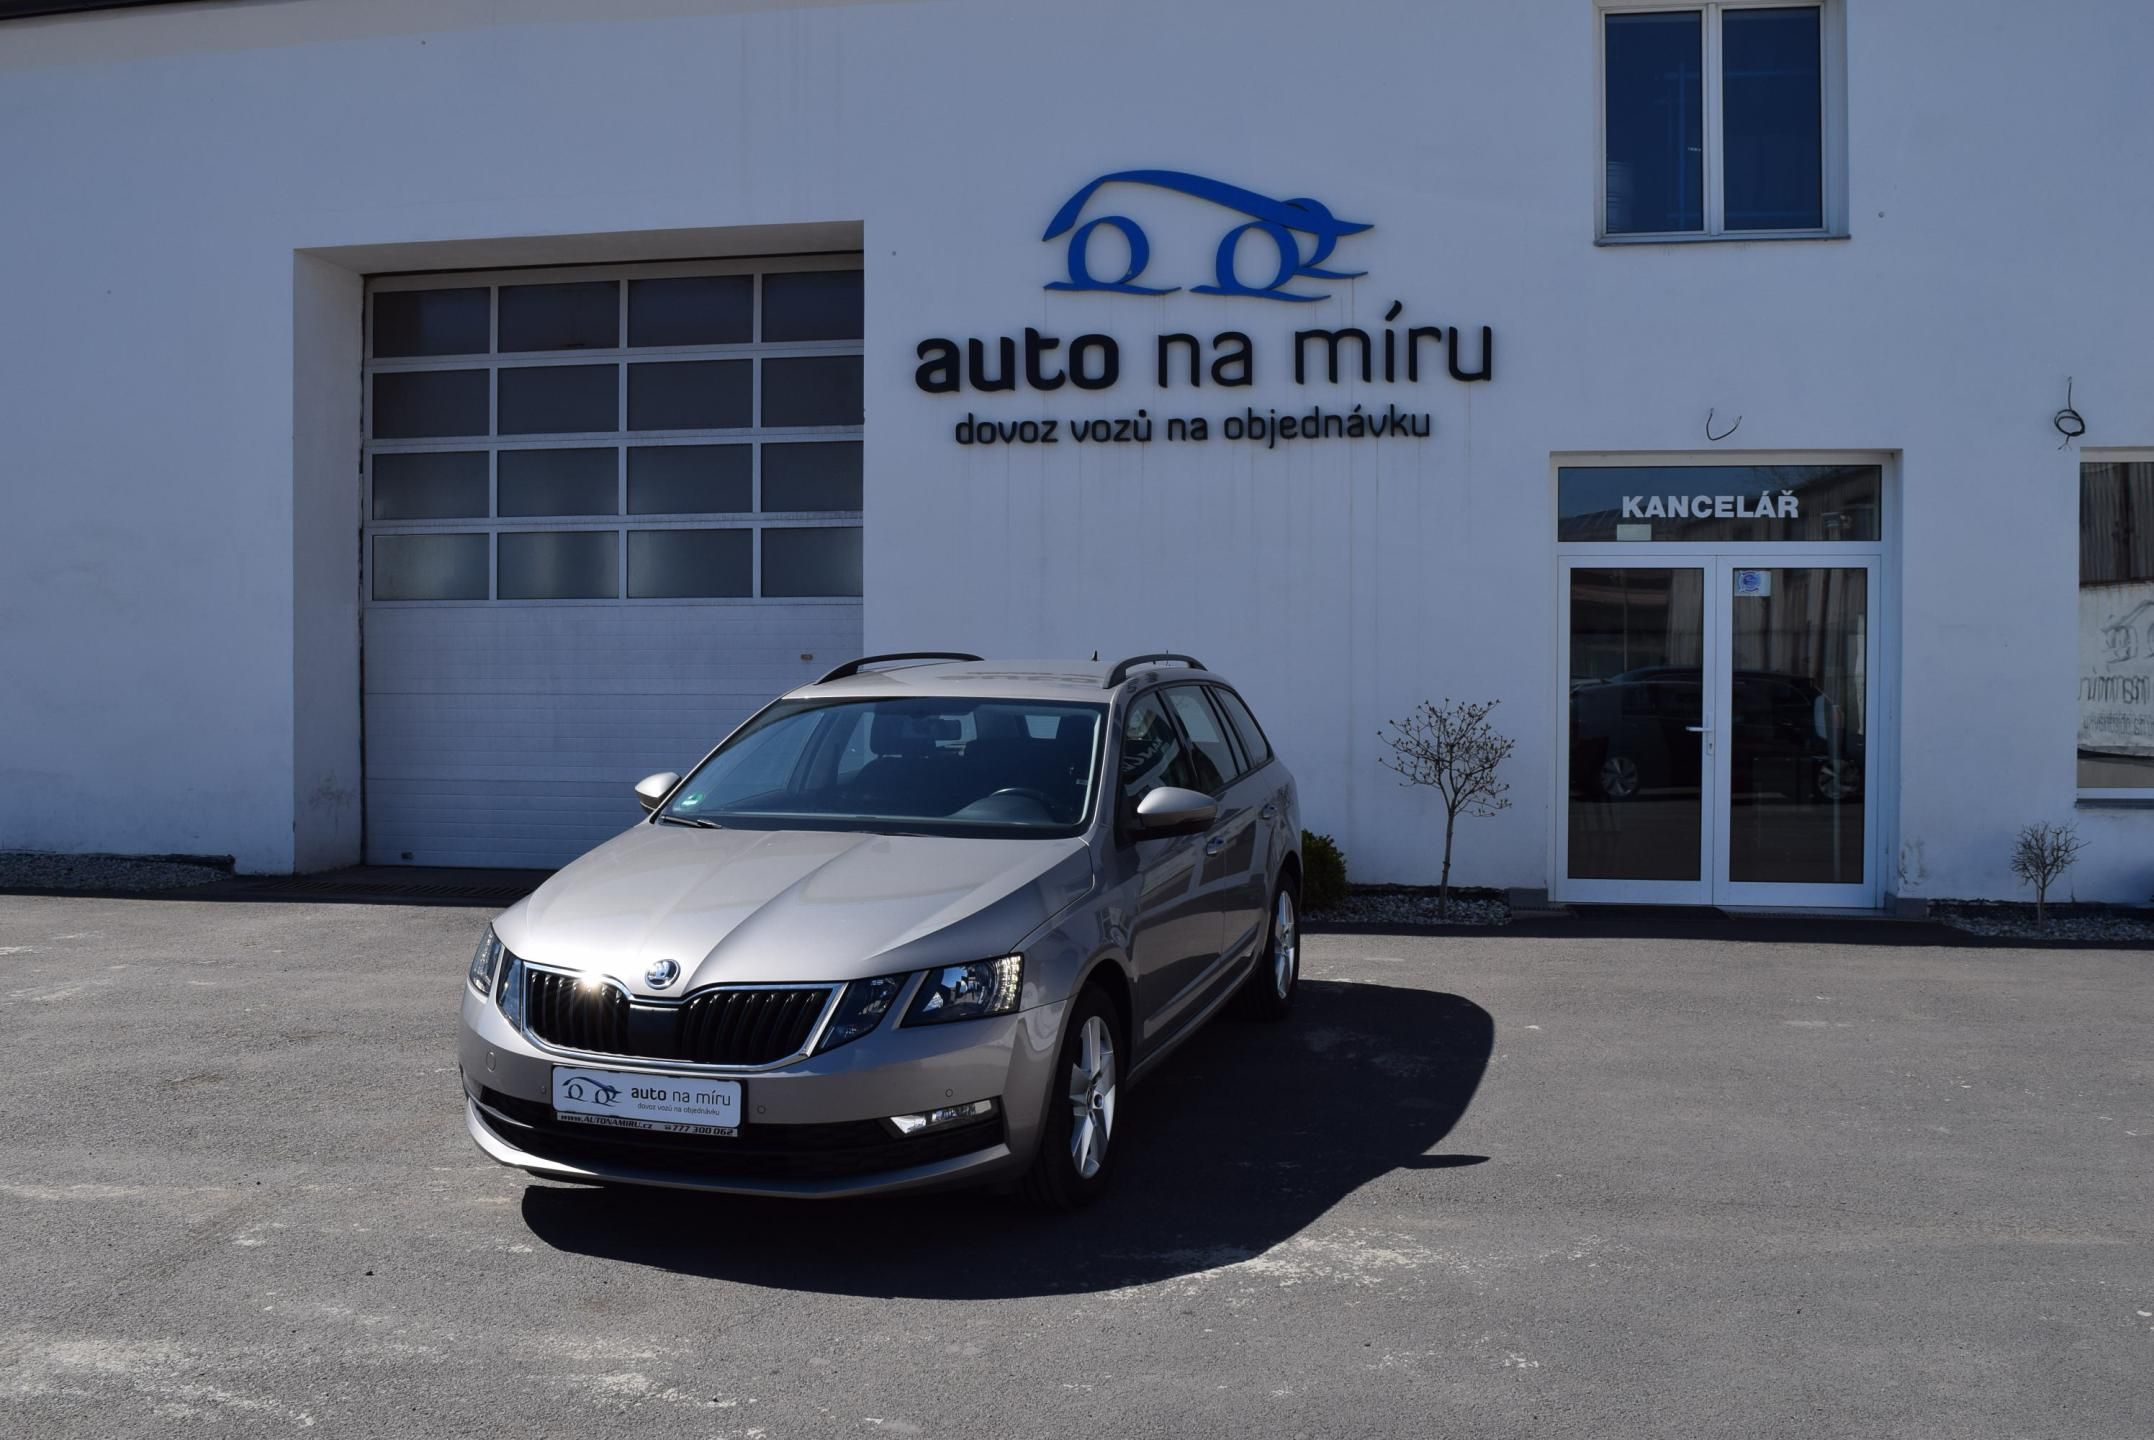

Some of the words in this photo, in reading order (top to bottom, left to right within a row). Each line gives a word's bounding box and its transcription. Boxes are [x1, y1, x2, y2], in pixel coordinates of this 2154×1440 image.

[914, 326, 1120, 394] auto
[1157, 330, 1254, 389] na
[1294, 299, 1493, 386] míru
[954, 412, 1059, 446] dovoz
[1069, 408, 1153, 445] vozů
[1166, 416, 1209, 442] na
[1223, 403, 1431, 450] objednávku
[1622, 489, 1799, 519] KANCELÁŘ
[631, 1087, 667, 1101] auto
[672, 1090, 690, 1103] na
[695, 1089, 731, 1106] míru
